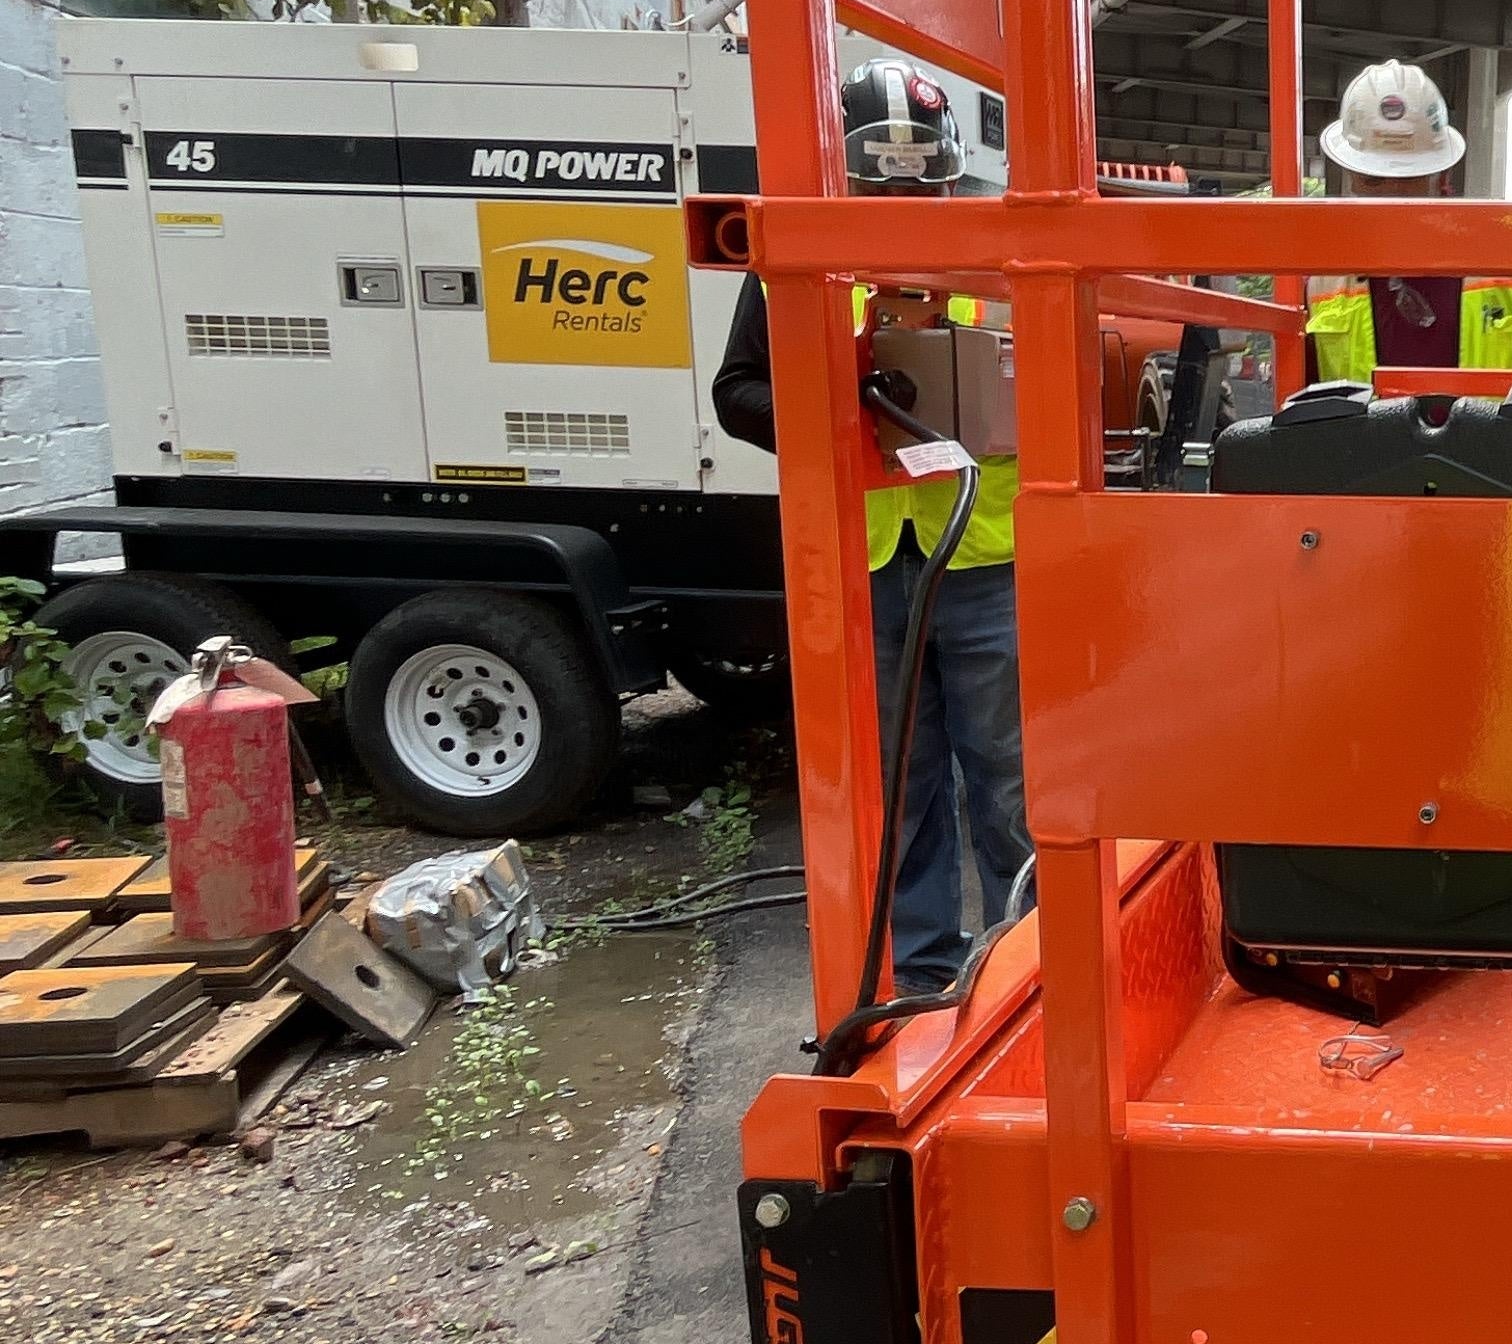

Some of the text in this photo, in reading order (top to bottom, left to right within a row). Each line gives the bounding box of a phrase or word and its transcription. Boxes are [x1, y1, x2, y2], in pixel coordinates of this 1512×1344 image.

[165, 140, 216, 173] 45
[471, 148, 665, 183] MQ POWER
[513, 258, 650, 307] Herc
[552, 310, 642, 333] Rentals
